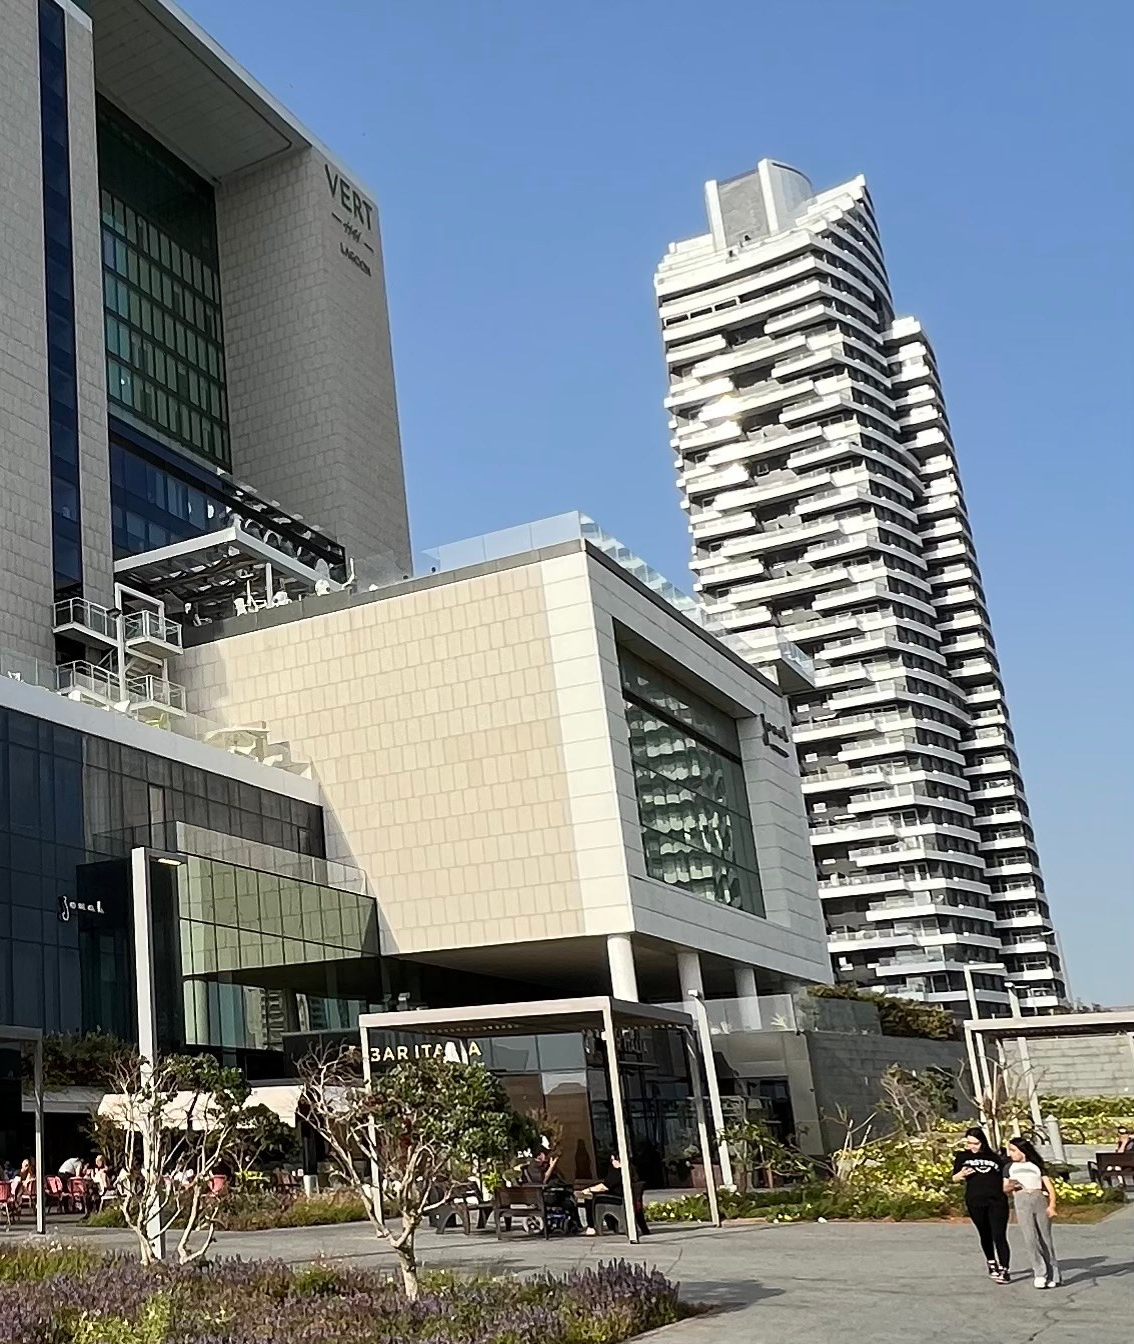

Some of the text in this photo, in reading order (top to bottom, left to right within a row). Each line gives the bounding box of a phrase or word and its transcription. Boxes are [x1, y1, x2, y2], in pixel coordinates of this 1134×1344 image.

[325, 164, 373, 230] VERT
[370, 1041, 482, 1063] BAR ITAA
